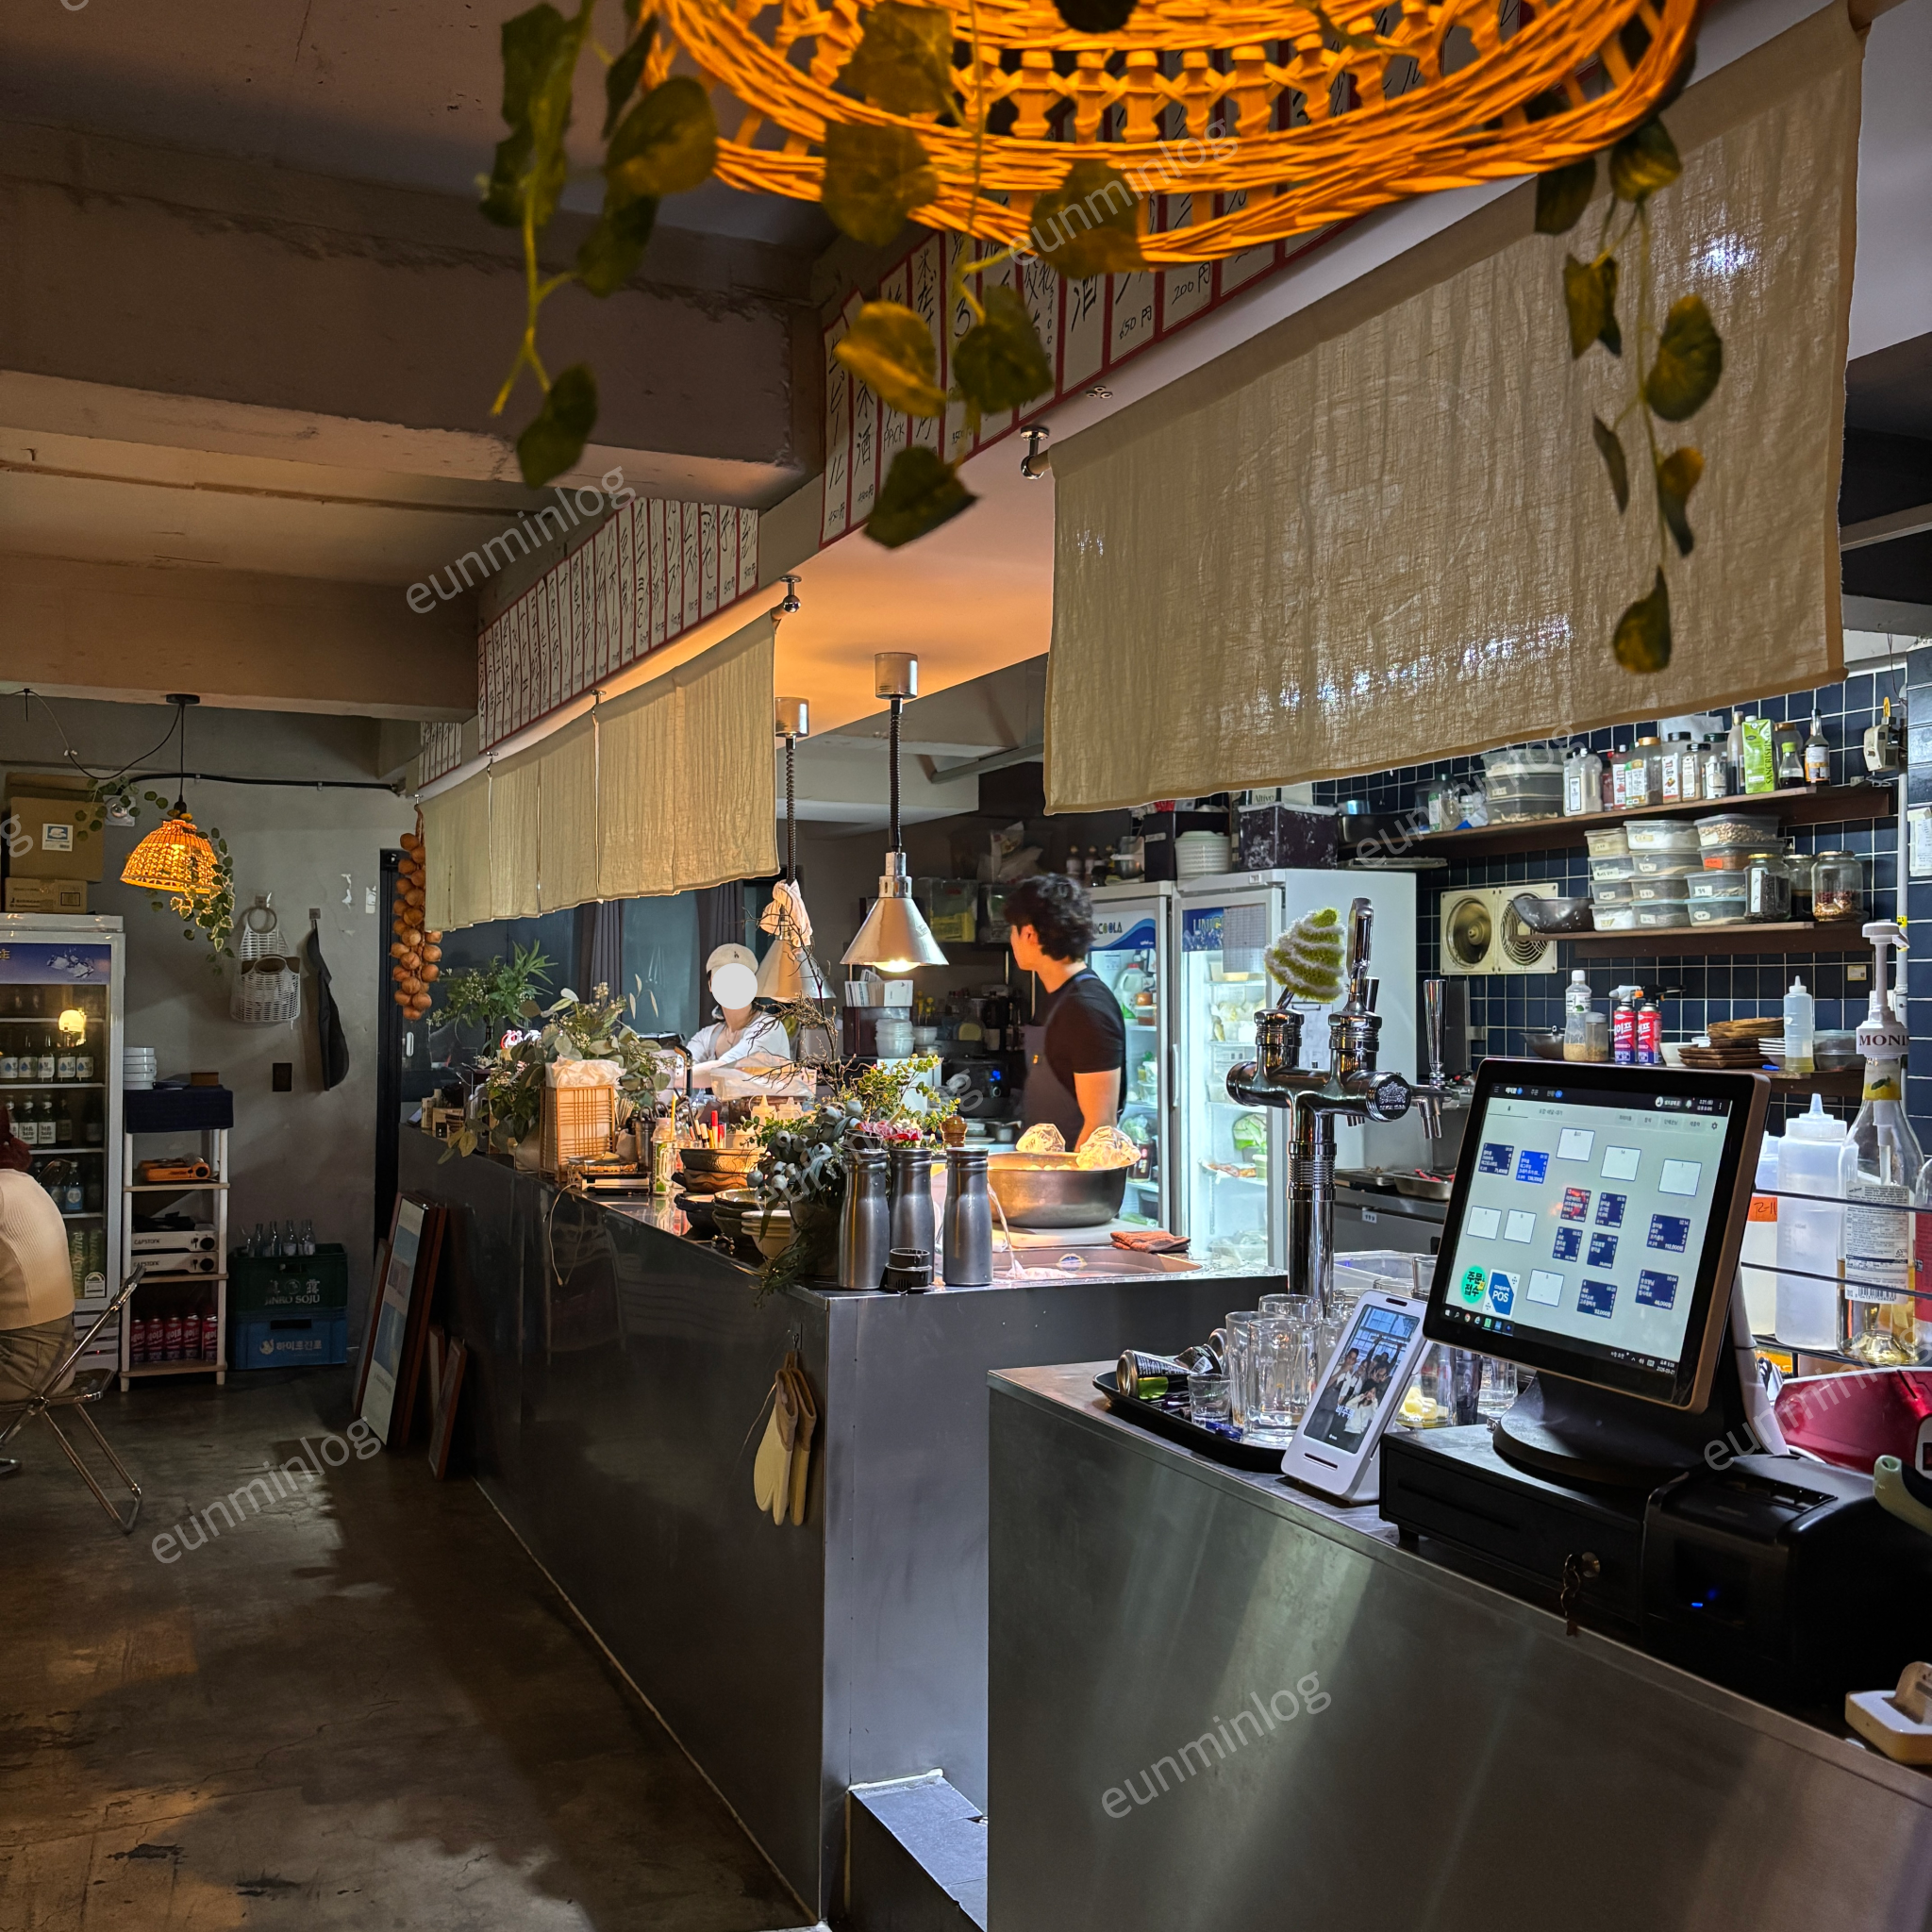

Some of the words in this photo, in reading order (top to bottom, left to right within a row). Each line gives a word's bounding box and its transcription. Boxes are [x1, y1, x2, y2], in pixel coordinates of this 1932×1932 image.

[1255, 794, 1274, 803] Altivo
[1467, 1271, 1482, 1285] 주문
[1464, 1283, 1479, 1297] 접수
[295, 1294, 321, 1304] SOJU
[1491, 1290, 1509, 1303] POS
[276, 1341, 322, 1351] 하이트진로
